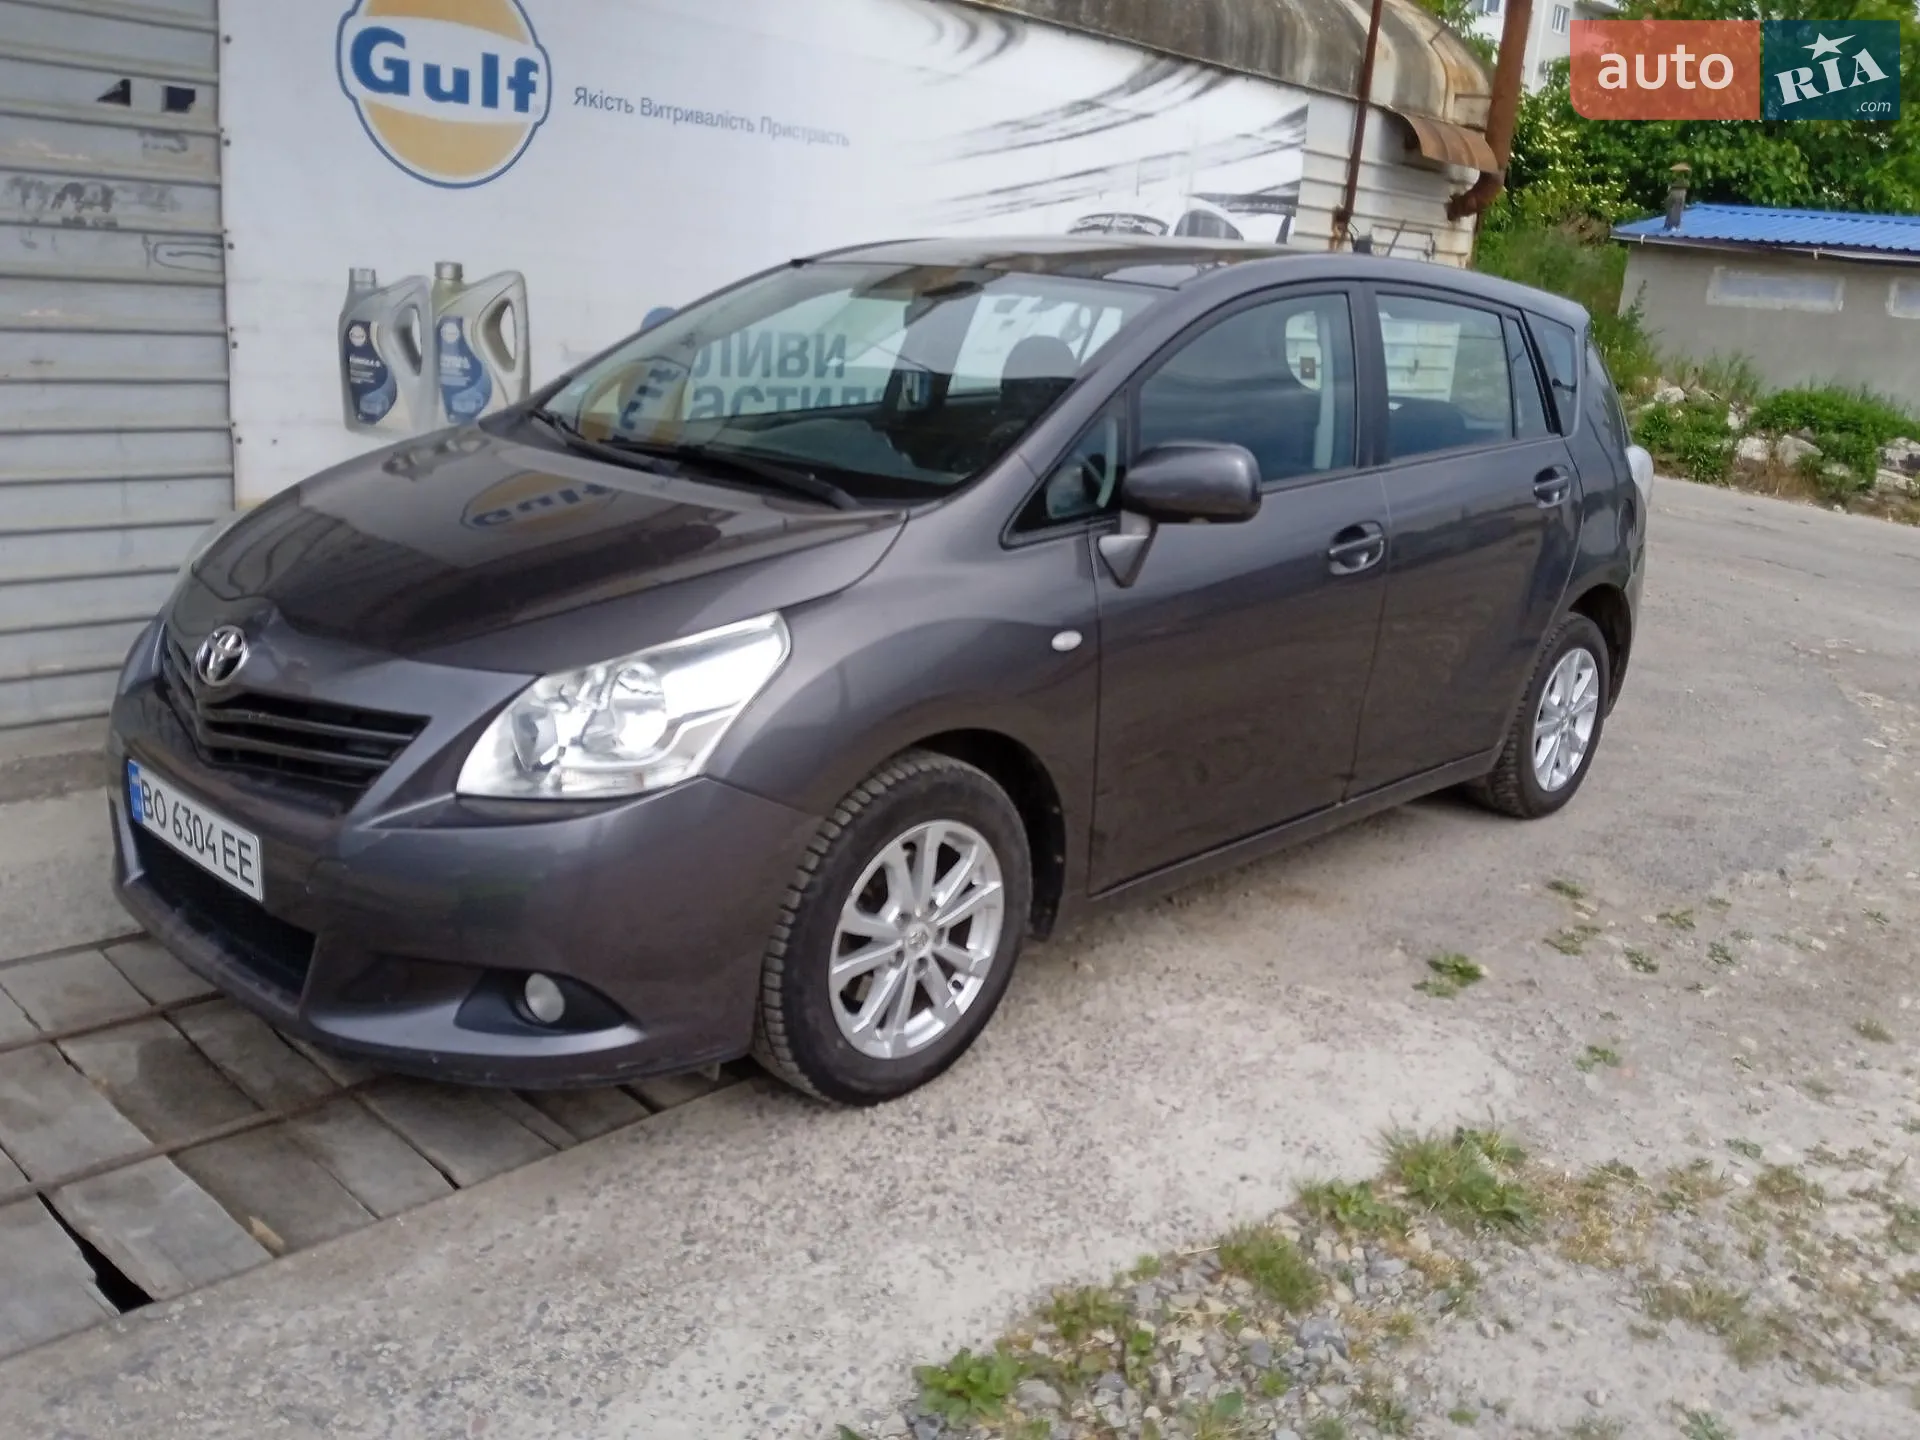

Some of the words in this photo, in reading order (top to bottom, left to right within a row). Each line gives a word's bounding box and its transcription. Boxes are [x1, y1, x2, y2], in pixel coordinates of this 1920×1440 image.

[350, 26, 540, 113] Gulf
[573, 86, 635, 115] Якість
[640, 97, 756, 133] Витривалість
[759, 115, 850, 147] Пристрасть
[141, 779, 167, 829] BO
[173, 801, 218, 865] 6304
[221, 830, 254, 887] EE
